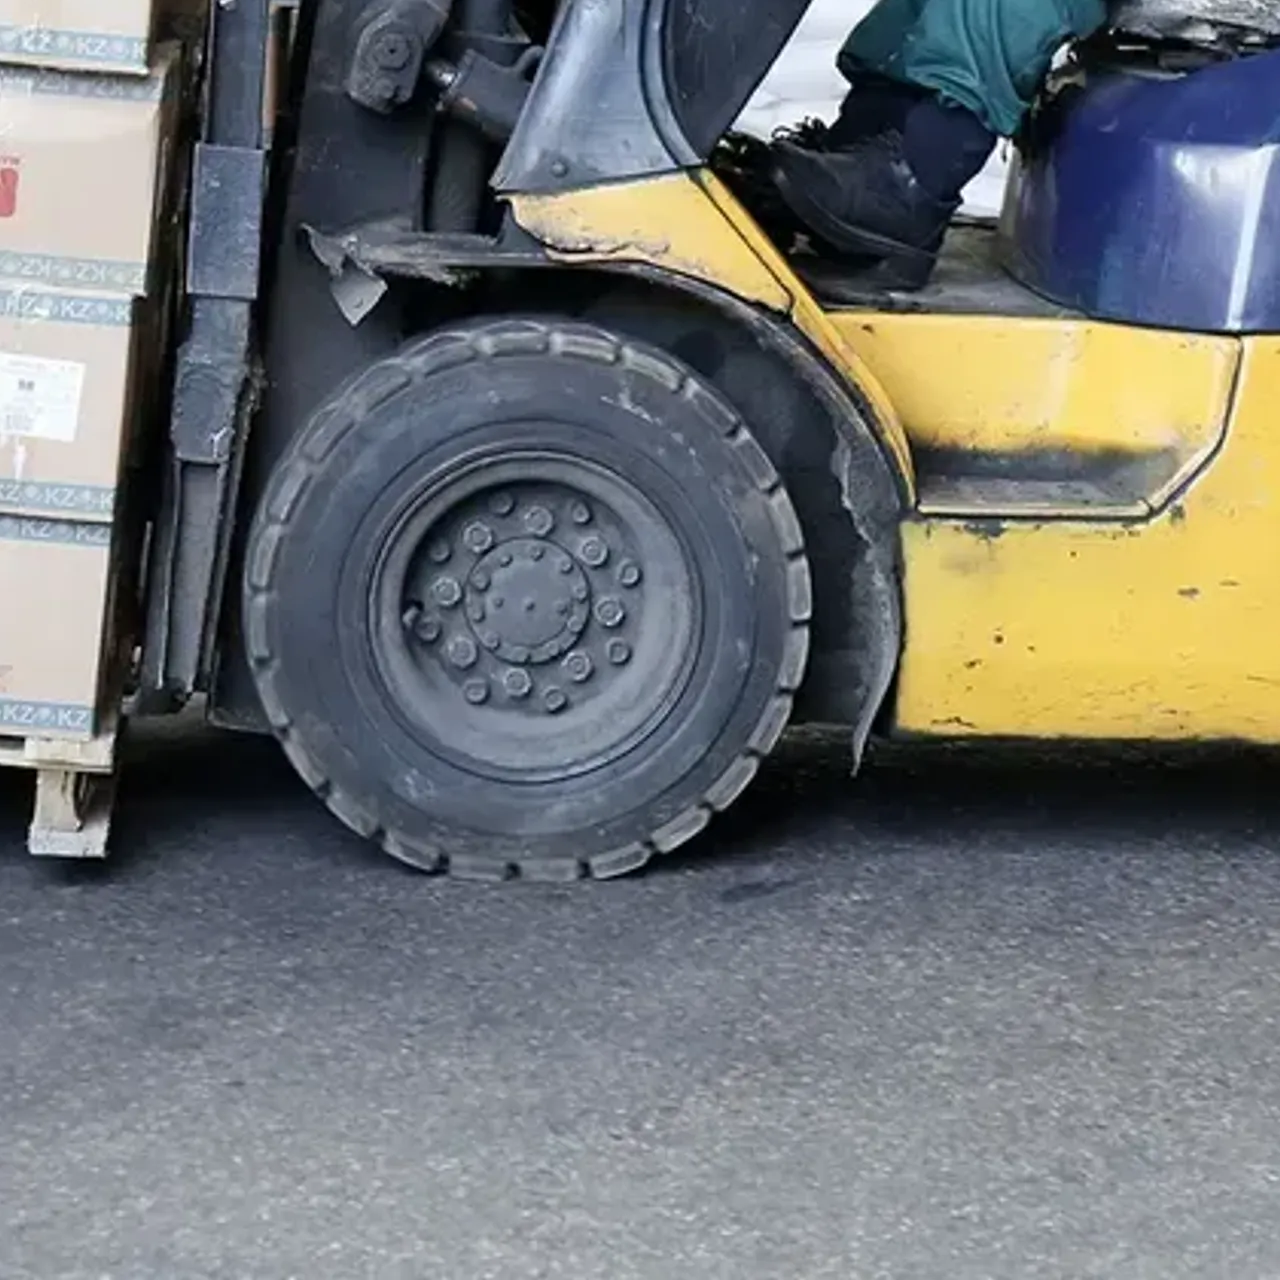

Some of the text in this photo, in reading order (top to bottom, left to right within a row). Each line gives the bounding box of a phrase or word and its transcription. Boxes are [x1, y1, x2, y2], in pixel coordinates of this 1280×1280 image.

[76, 37, 108, 56] KZ
[20, 258, 51, 277] KZ
[75, 263, 107, 282] KZ
[60, 299, 92, 318] KZ
[44, 487, 75, 506] KZ
[20, 519, 52, 538] KZ
[3, 704, 34, 723] KZ
[57, 708, 89, 727] KZ
